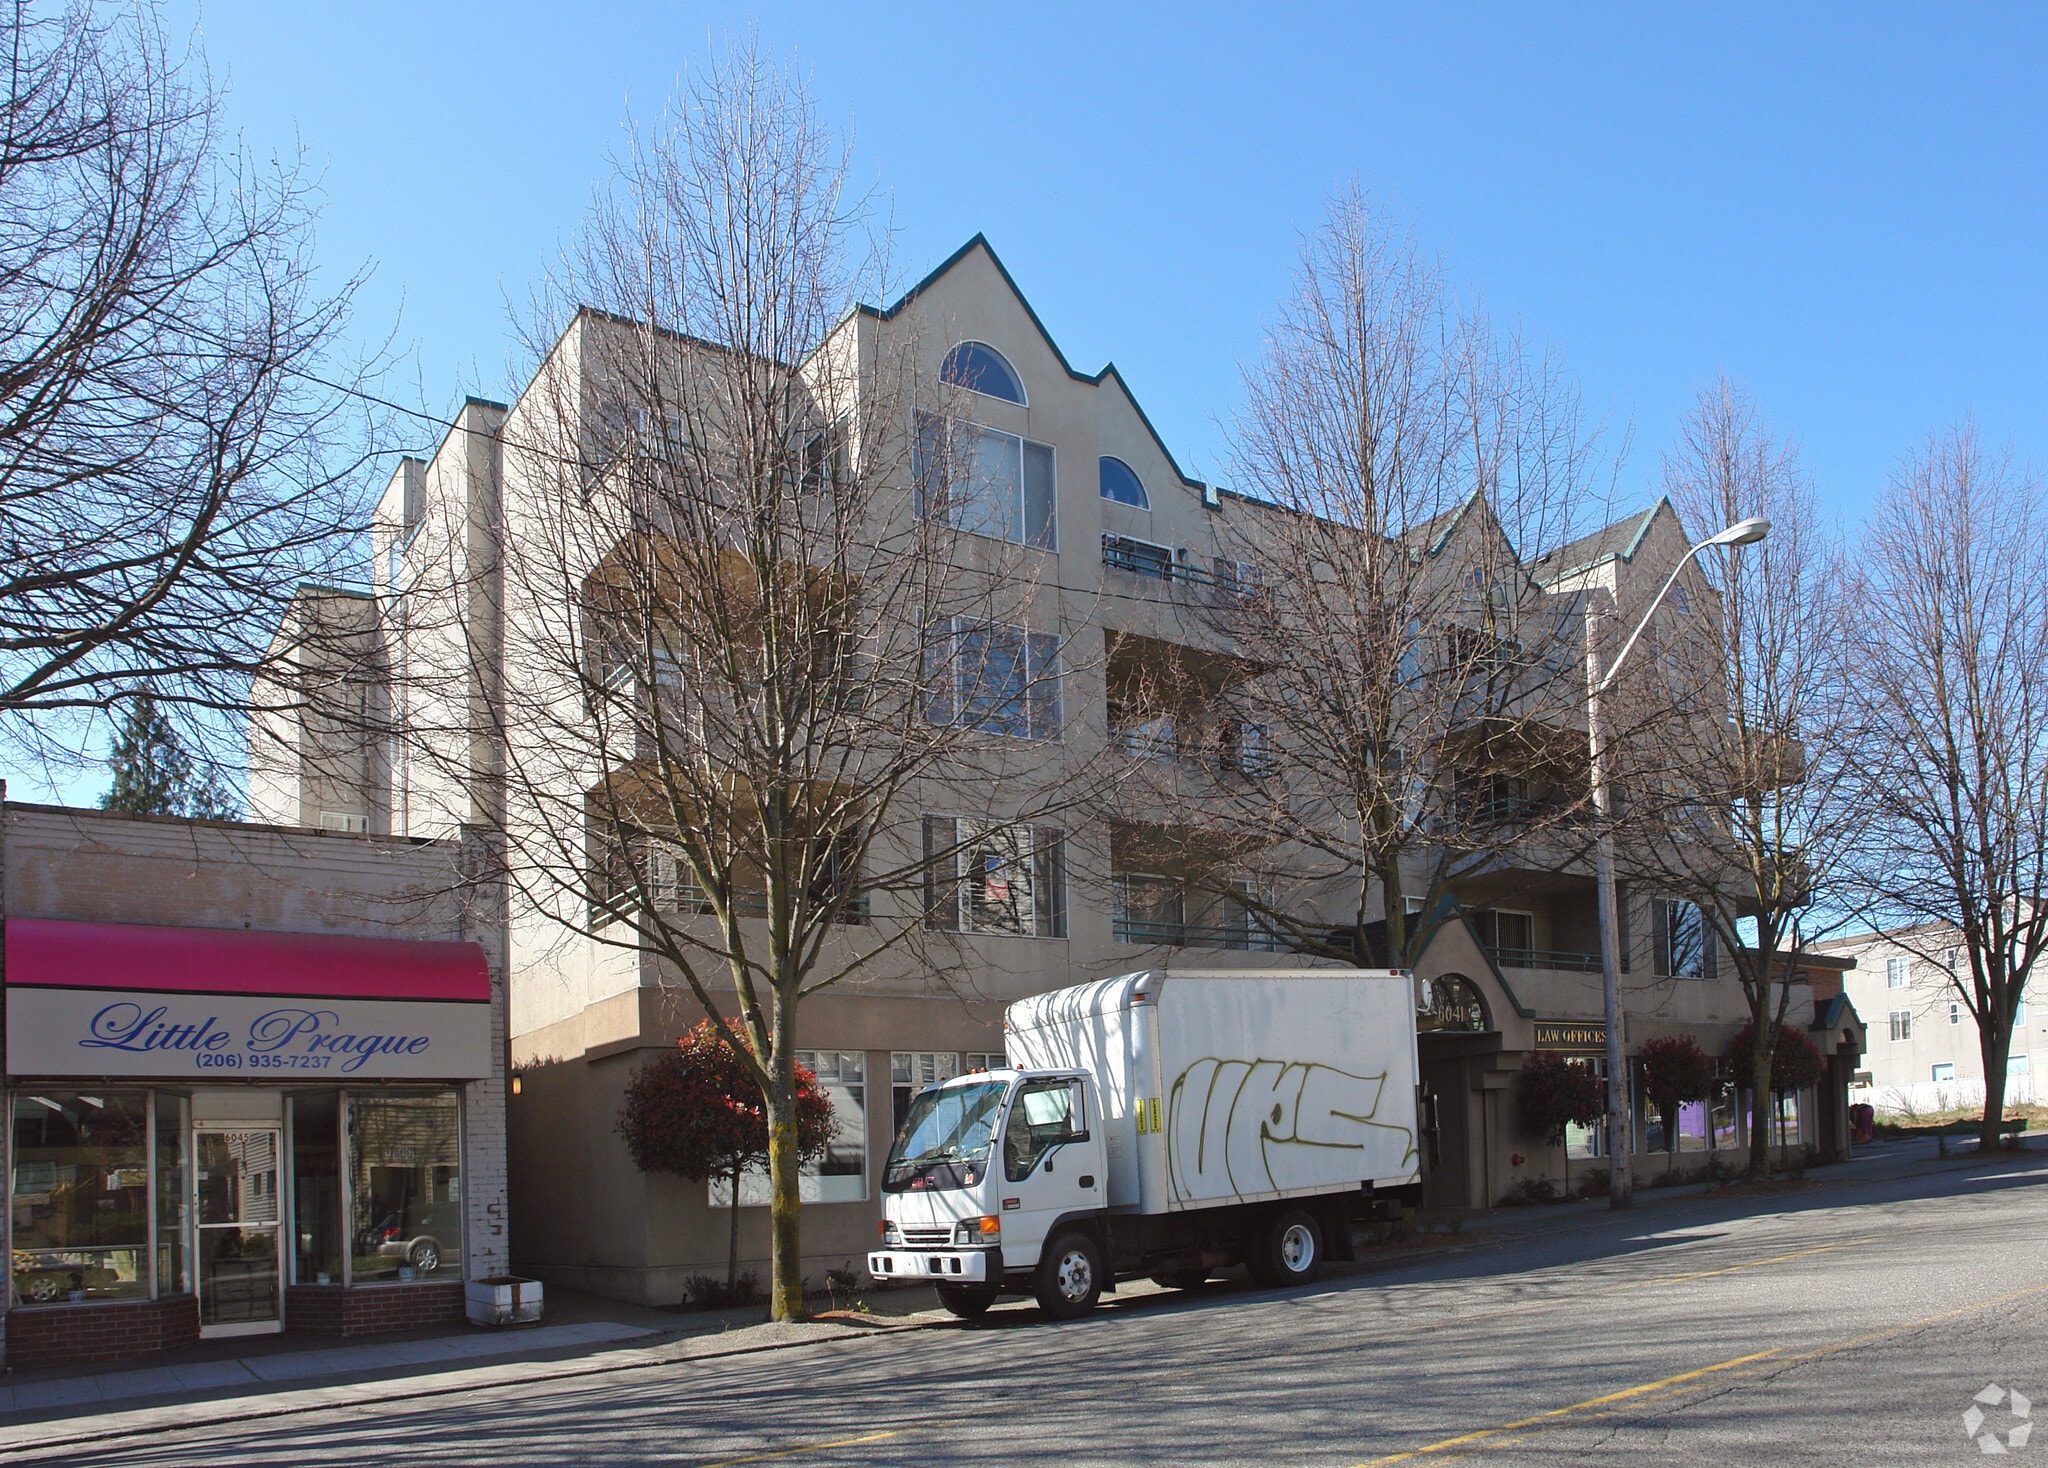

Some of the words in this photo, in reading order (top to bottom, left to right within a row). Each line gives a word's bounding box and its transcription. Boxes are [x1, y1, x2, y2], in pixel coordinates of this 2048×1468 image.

[1438, 1004, 1464, 1022] 6041
[79, 1002, 230, 1052] Little
[246, 1008, 431, 1073] Prague
[1537, 1029, 1559, 1043] LAW
[1562, 1029, 1607, 1043] OFFICES
[195, 1052, 243, 1069] (206)
[249, 1054, 331, 1069] 935-7237
[225, 1133, 250, 1142] 6045
